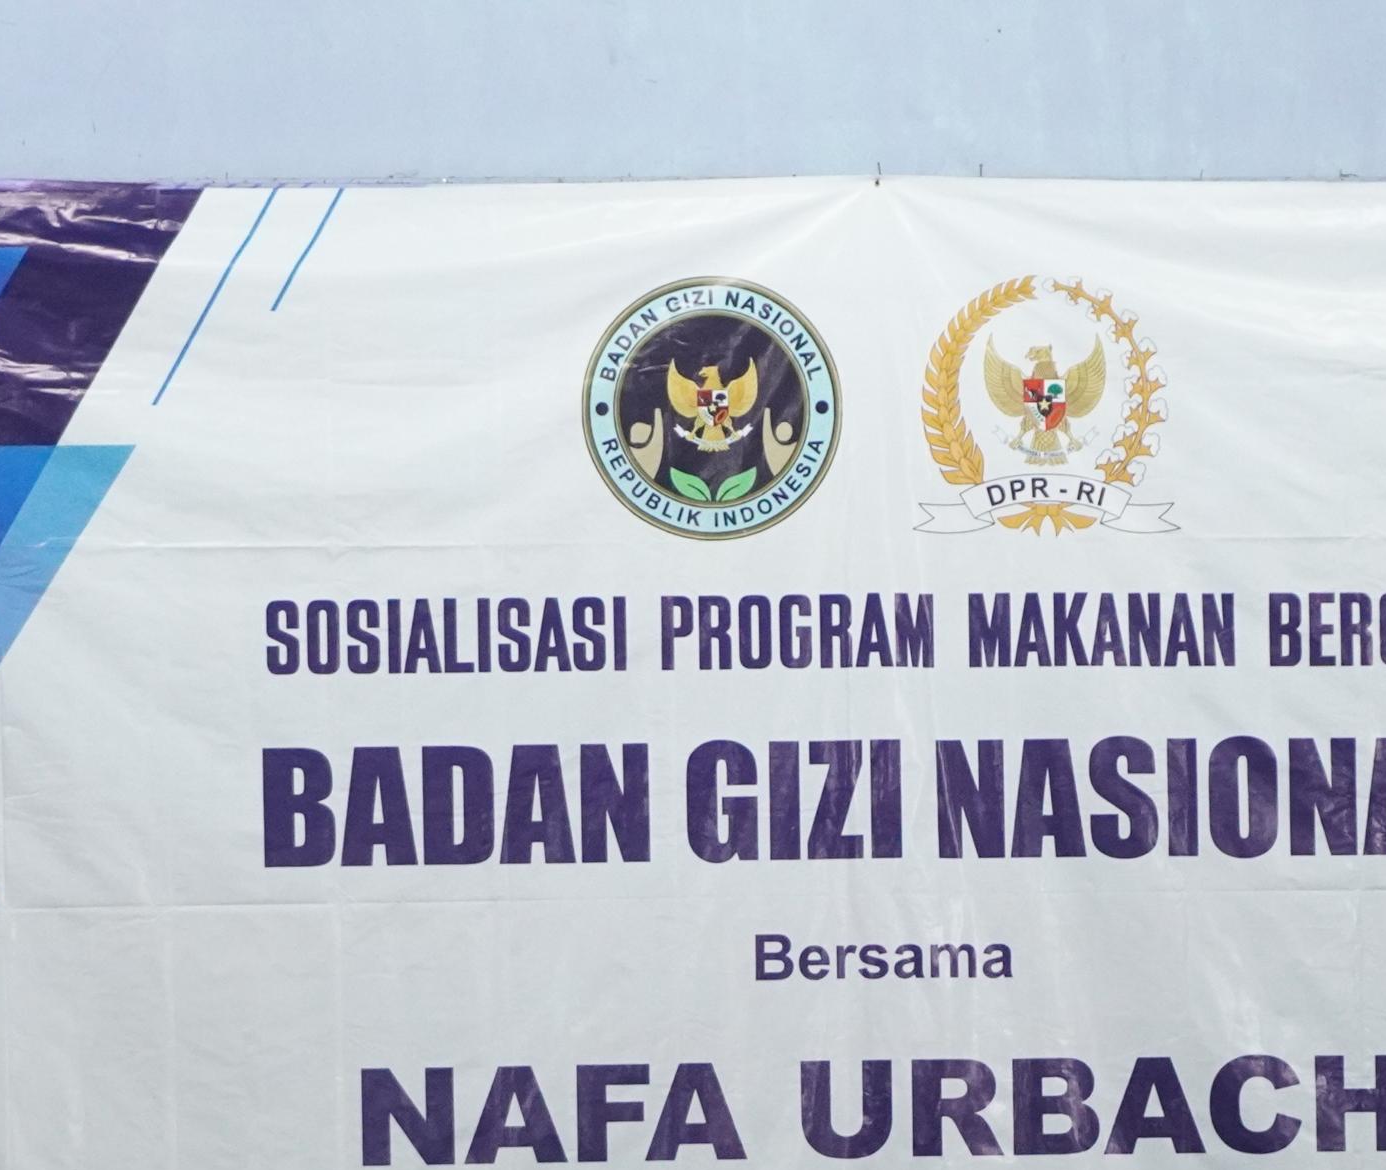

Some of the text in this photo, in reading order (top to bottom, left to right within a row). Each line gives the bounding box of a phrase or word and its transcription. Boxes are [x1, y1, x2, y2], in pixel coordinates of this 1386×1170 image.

[599, 289, 823, 382] BADAN GIZI NASIONAL
[602, 437, 824, 528] REPUBLIK INDONESIA
[986, 477, 1049, 506] DPR
[1076, 481, 1106, 506] RI
[265, 596, 627, 675] SOSIALISASI
[660, 592, 934, 671] PROGRAM
[968, 592, 1236, 668] MAKANAN
[261, 742, 651, 868] BADAN
[685, 739, 903, 864] GIZI
[755, 934, 1013, 981] Bersama
[360, 1062, 748, 1167] NAFA
